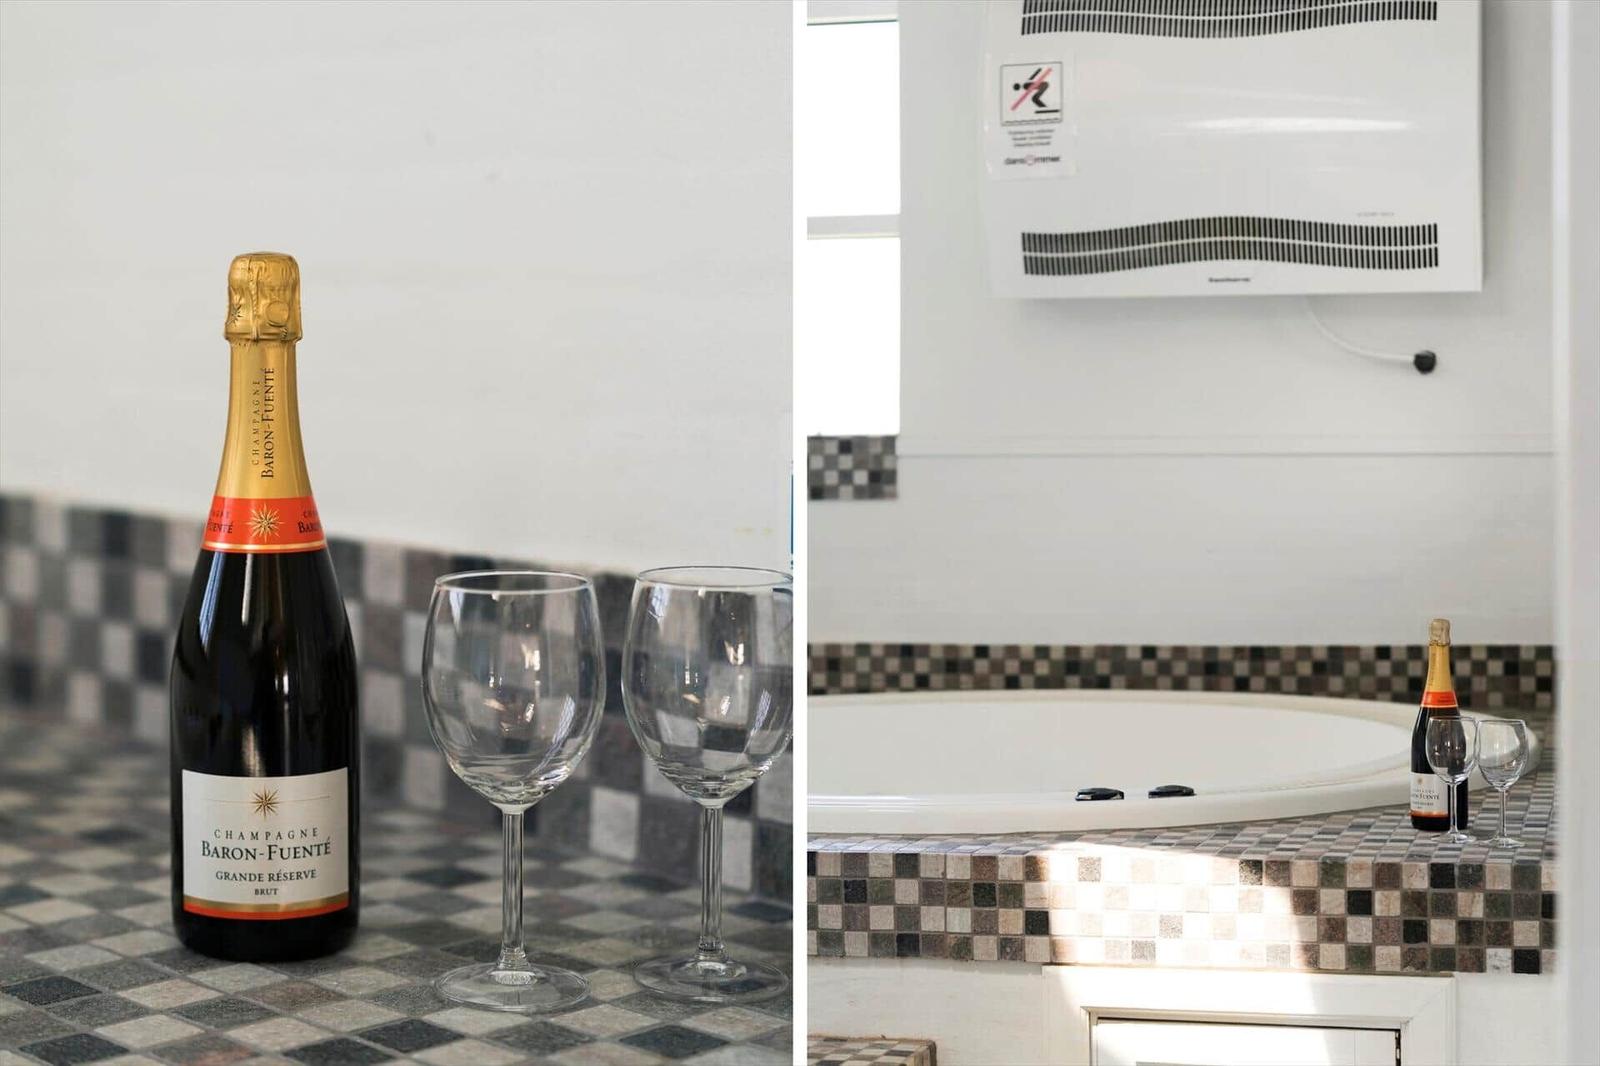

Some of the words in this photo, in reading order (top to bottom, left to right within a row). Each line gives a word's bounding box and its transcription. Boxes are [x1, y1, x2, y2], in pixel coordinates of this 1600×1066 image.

[252, 380, 260, 466] CHAMPAGNE
[260, 367, 275, 478] BARON-FUENTÉ
[214, 827, 318, 841] CHAMPAGNE
[201, 836, 331, 861] BARON-FUENTÉ
[215, 870, 264, 882] GRANDE
[267, 868, 317, 882] RÉSERVE
[254, 888, 278, 896] BRUT
